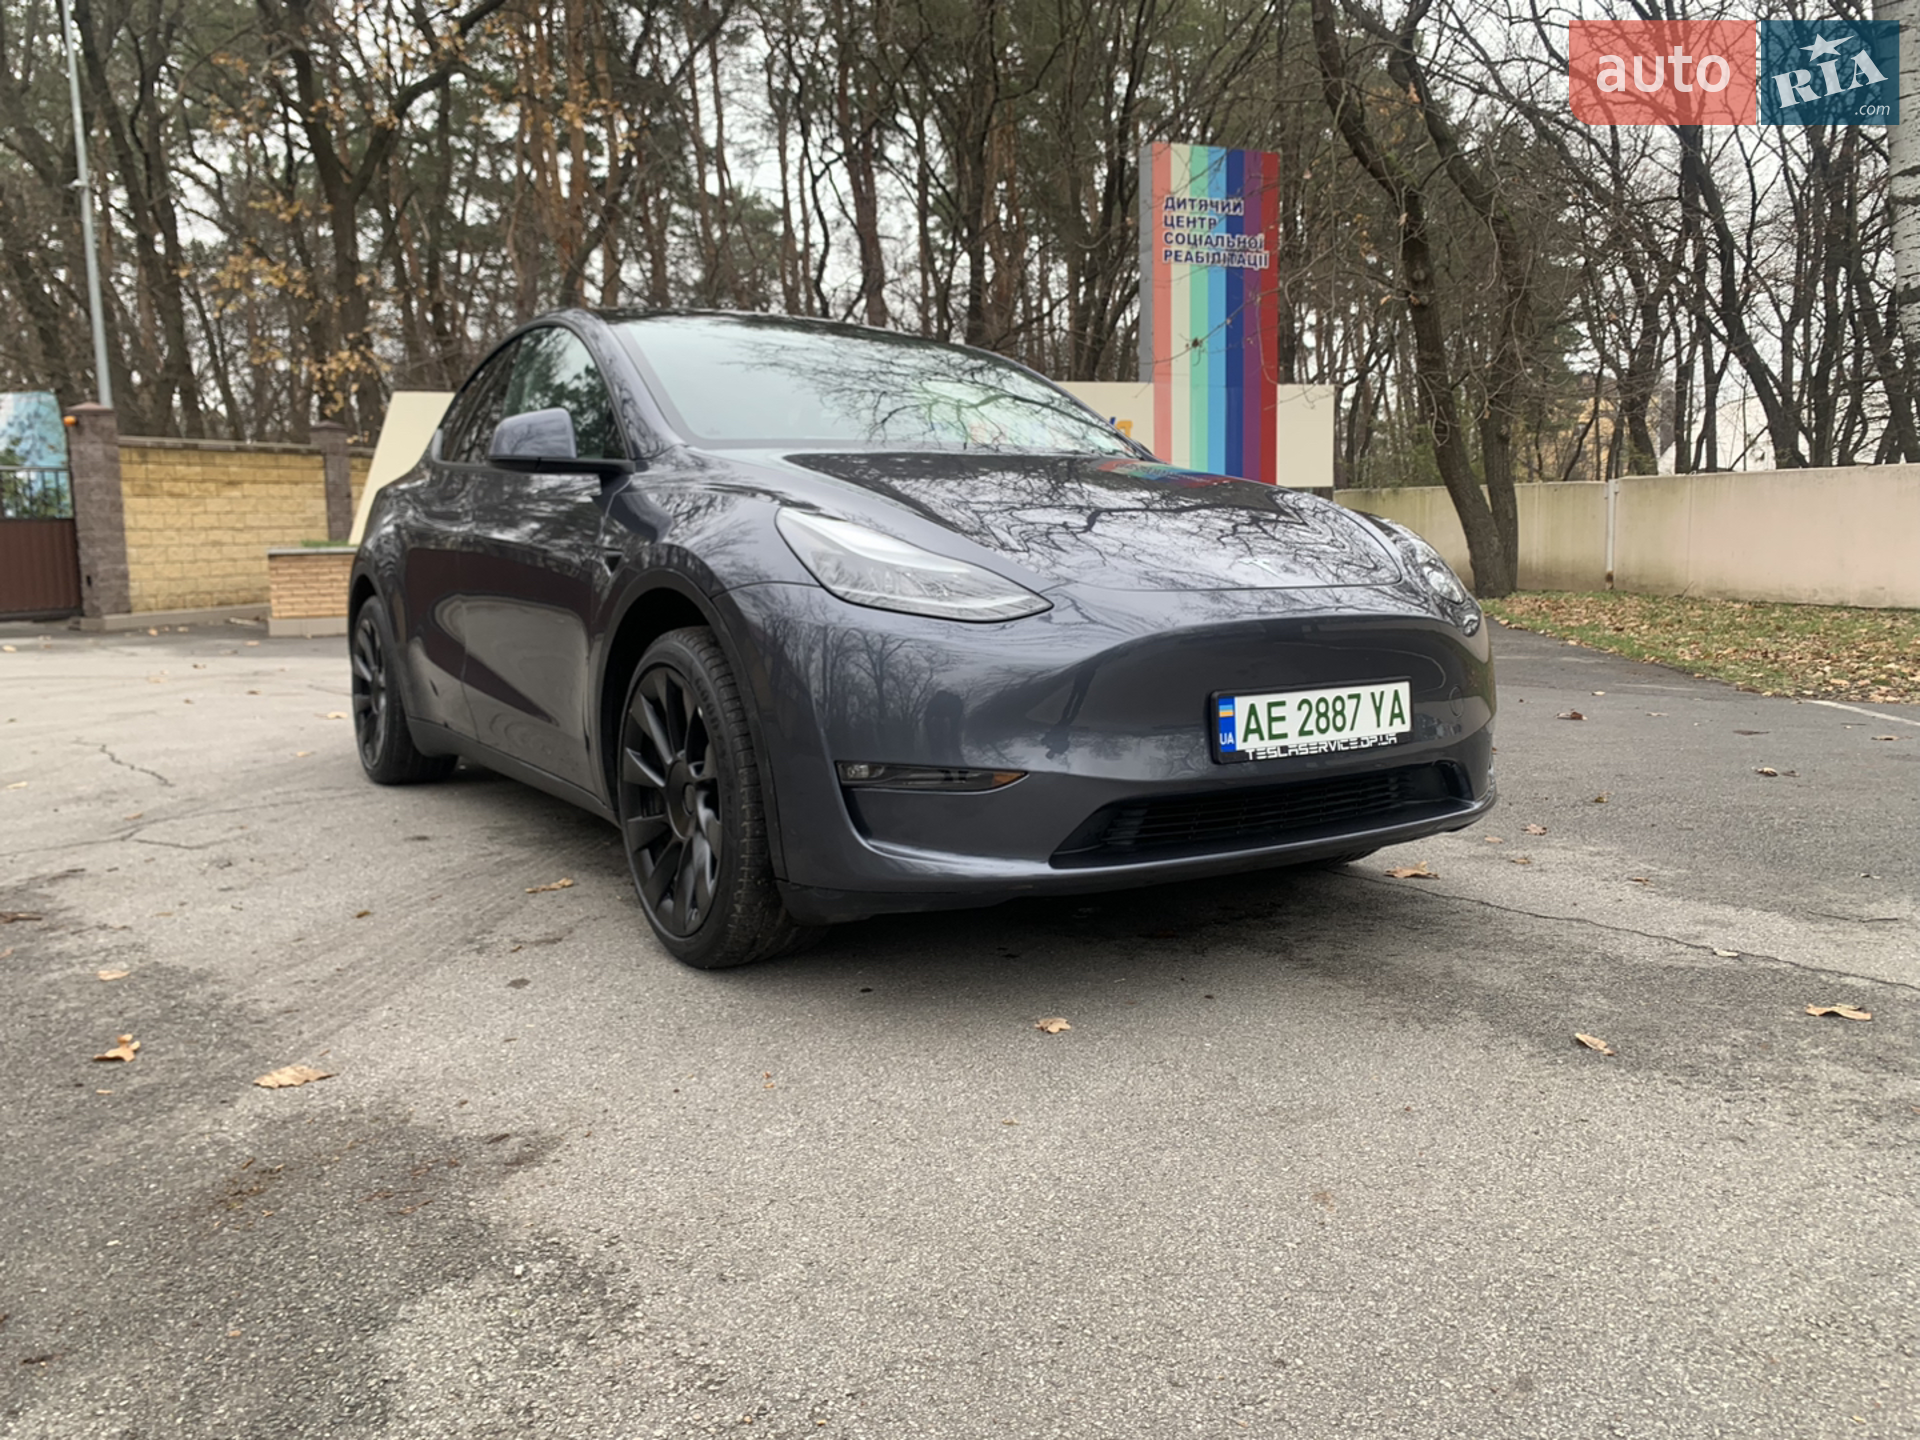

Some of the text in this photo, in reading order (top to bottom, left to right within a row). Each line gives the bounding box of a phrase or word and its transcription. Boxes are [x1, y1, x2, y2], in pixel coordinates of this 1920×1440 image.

[1163, 195, 1244, 214] ДИТЯЧИЙ
[1163, 214, 1218, 230] ЦЕНТР
[1163, 231, 1264, 249] СОЦІАЛЬНОЇ
[1163, 249, 1268, 268] РЕАБІЛІТАЦІЇ
[1242, 689, 1406, 743] AE 2887 YA
[1219, 732, 1235, 745] UA
